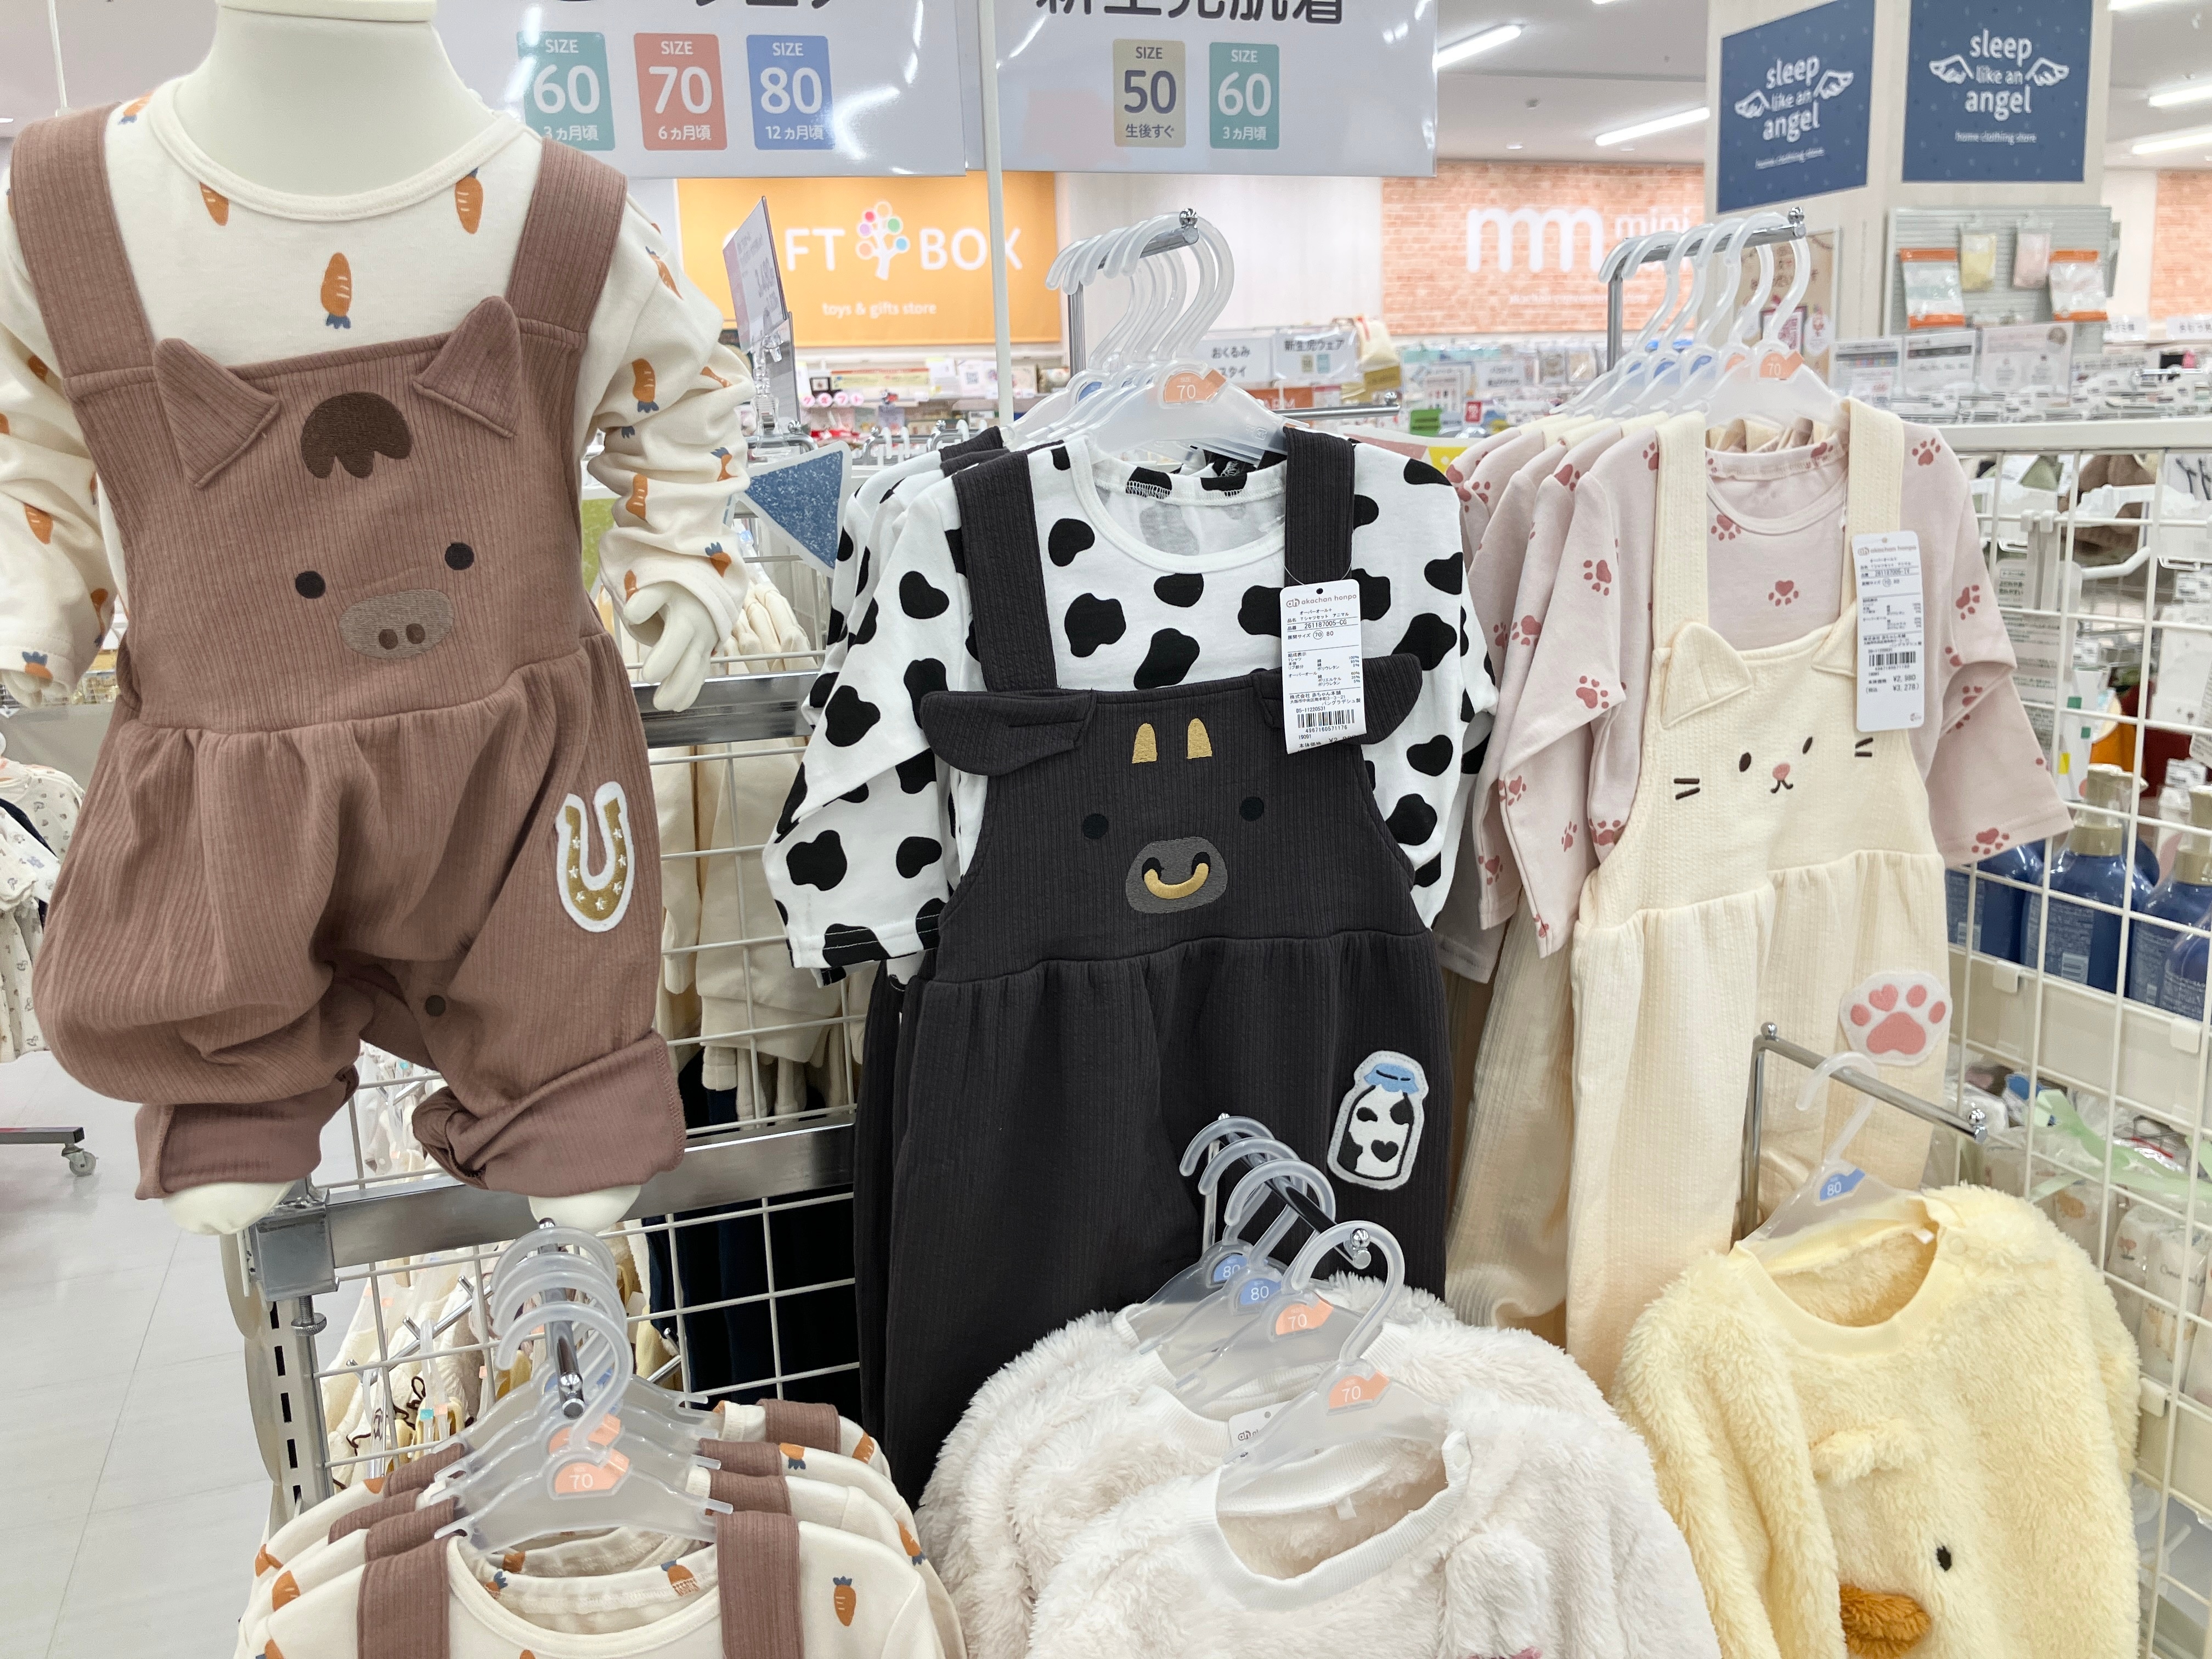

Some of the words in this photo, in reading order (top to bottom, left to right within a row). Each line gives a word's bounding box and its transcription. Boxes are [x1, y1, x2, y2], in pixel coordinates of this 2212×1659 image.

[545, 39, 579, 54] SIZE
[661, 41, 693, 55] SIZE
[772, 42, 804, 57] SIZE
[1136, 47, 1163, 60] SIZE
[1970, 29, 2033, 66] sleep
[1231, 50, 1258, 64] SIZE
[1765, 55, 1820, 88] sleep
[1976, 65, 2002, 84] like
[2005, 69, 2023, 84] an
[533, 65, 600, 115] 60
[648, 66, 713, 115] 70
[759, 67, 822, 115] 80
[1124, 70, 1177, 115] 50
[1217, 72, 1272, 117] 60
[1771, 91, 1794, 111] like
[1795, 89, 1812, 106] an
[1965, 86, 2032, 121] angel
[1762, 101, 1820, 143] angel
[1125, 123, 1175, 139] 生後すぐ
[823, 302, 852, 318] toys
[855, 303, 866, 314] &
[870, 302, 899, 318] gifts
[902, 303, 936, 314] store
[1211, 346, 1250, 359] おくるみ
[1767, 363, 1781, 376] 70
[1177, 384, 1196, 399] 70
[1305, 619, 1346, 629] 261187005-CG
[1827, 1181, 1842, 1196] 80
[1223, 1264, 1240, 1278] 80
[1251, 1286, 1269, 1300] 80
[1288, 1314, 1307, 1329] 70
[1342, 1386, 1361, 1402] 70
[569, 1473, 593, 1489] 70
